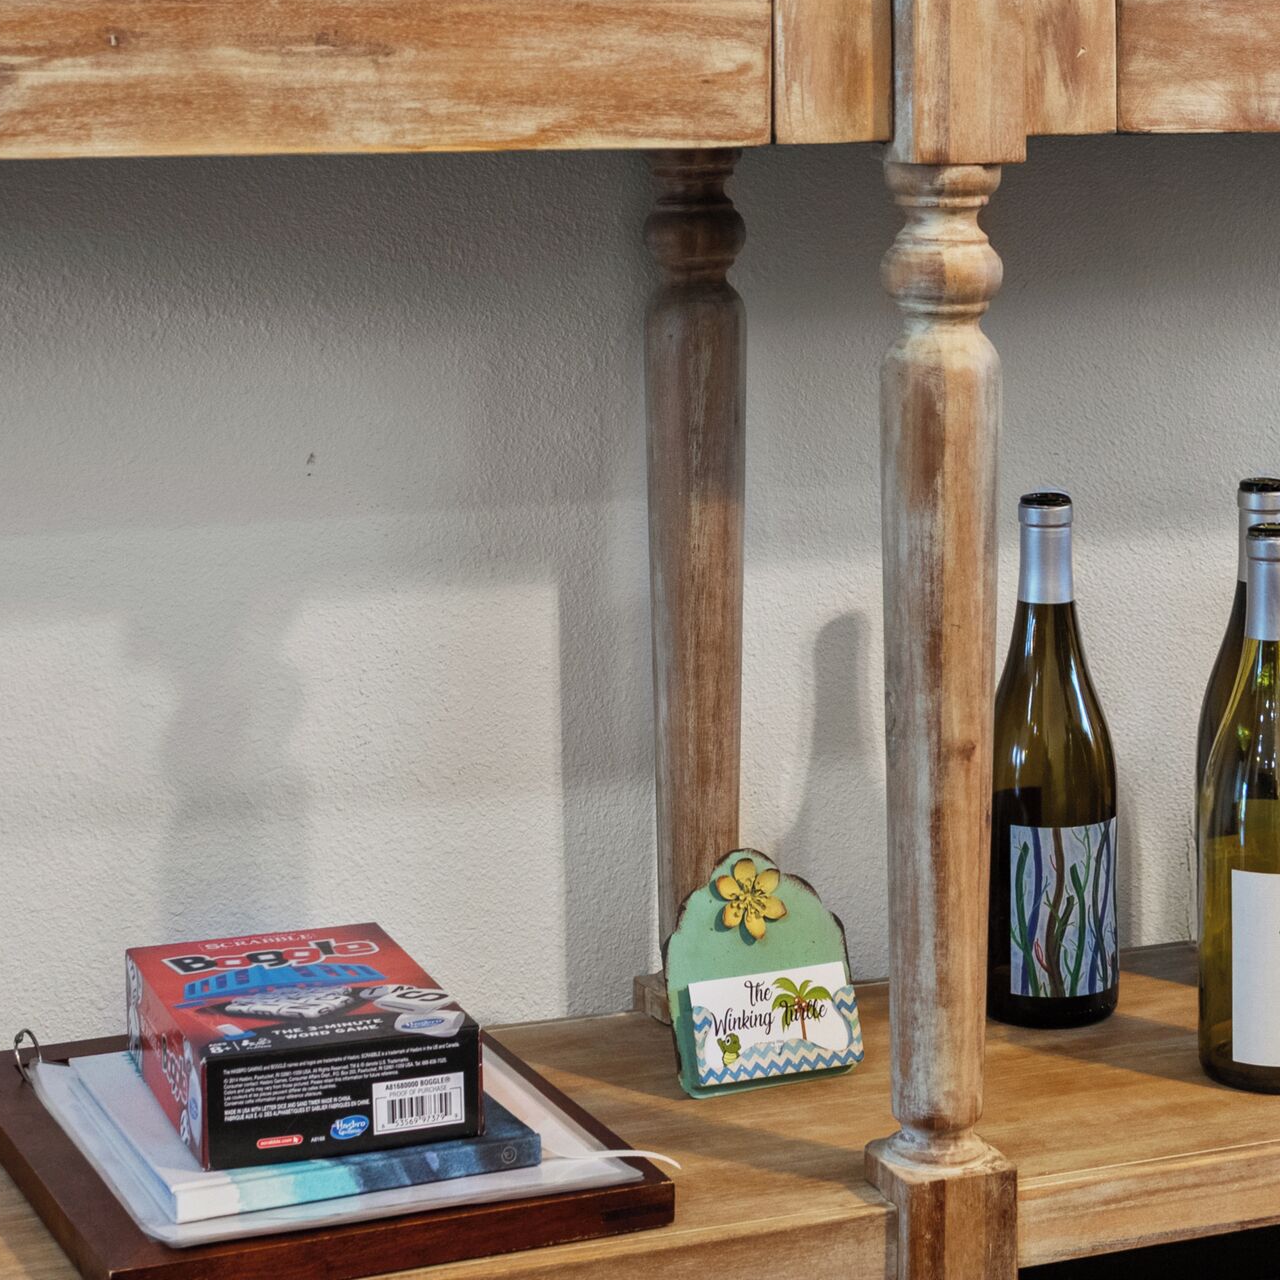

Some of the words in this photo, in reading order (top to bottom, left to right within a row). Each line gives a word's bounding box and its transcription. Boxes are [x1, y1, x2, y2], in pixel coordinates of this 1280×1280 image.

[204, 934, 311, 950] SCRABBLE
[162, 937, 380, 975] Boggle
[744, 980, 773, 1007] The
[711, 1007, 775, 1037] Winking
[780, 998, 828, 1027] Turtle
[271, 1027, 303, 1036] THE
[308, 1018, 384, 1032] 3-MINUTE
[284, 1030, 330, 1039] WORD
[335, 1024, 380, 1034] GAME
[389, 1089, 408, 1098] PROOF
[409, 1088, 417, 1096] OF
[417, 1085, 447, 1095] PURCHASE
[335, 1119, 366, 1130] Hasbro
